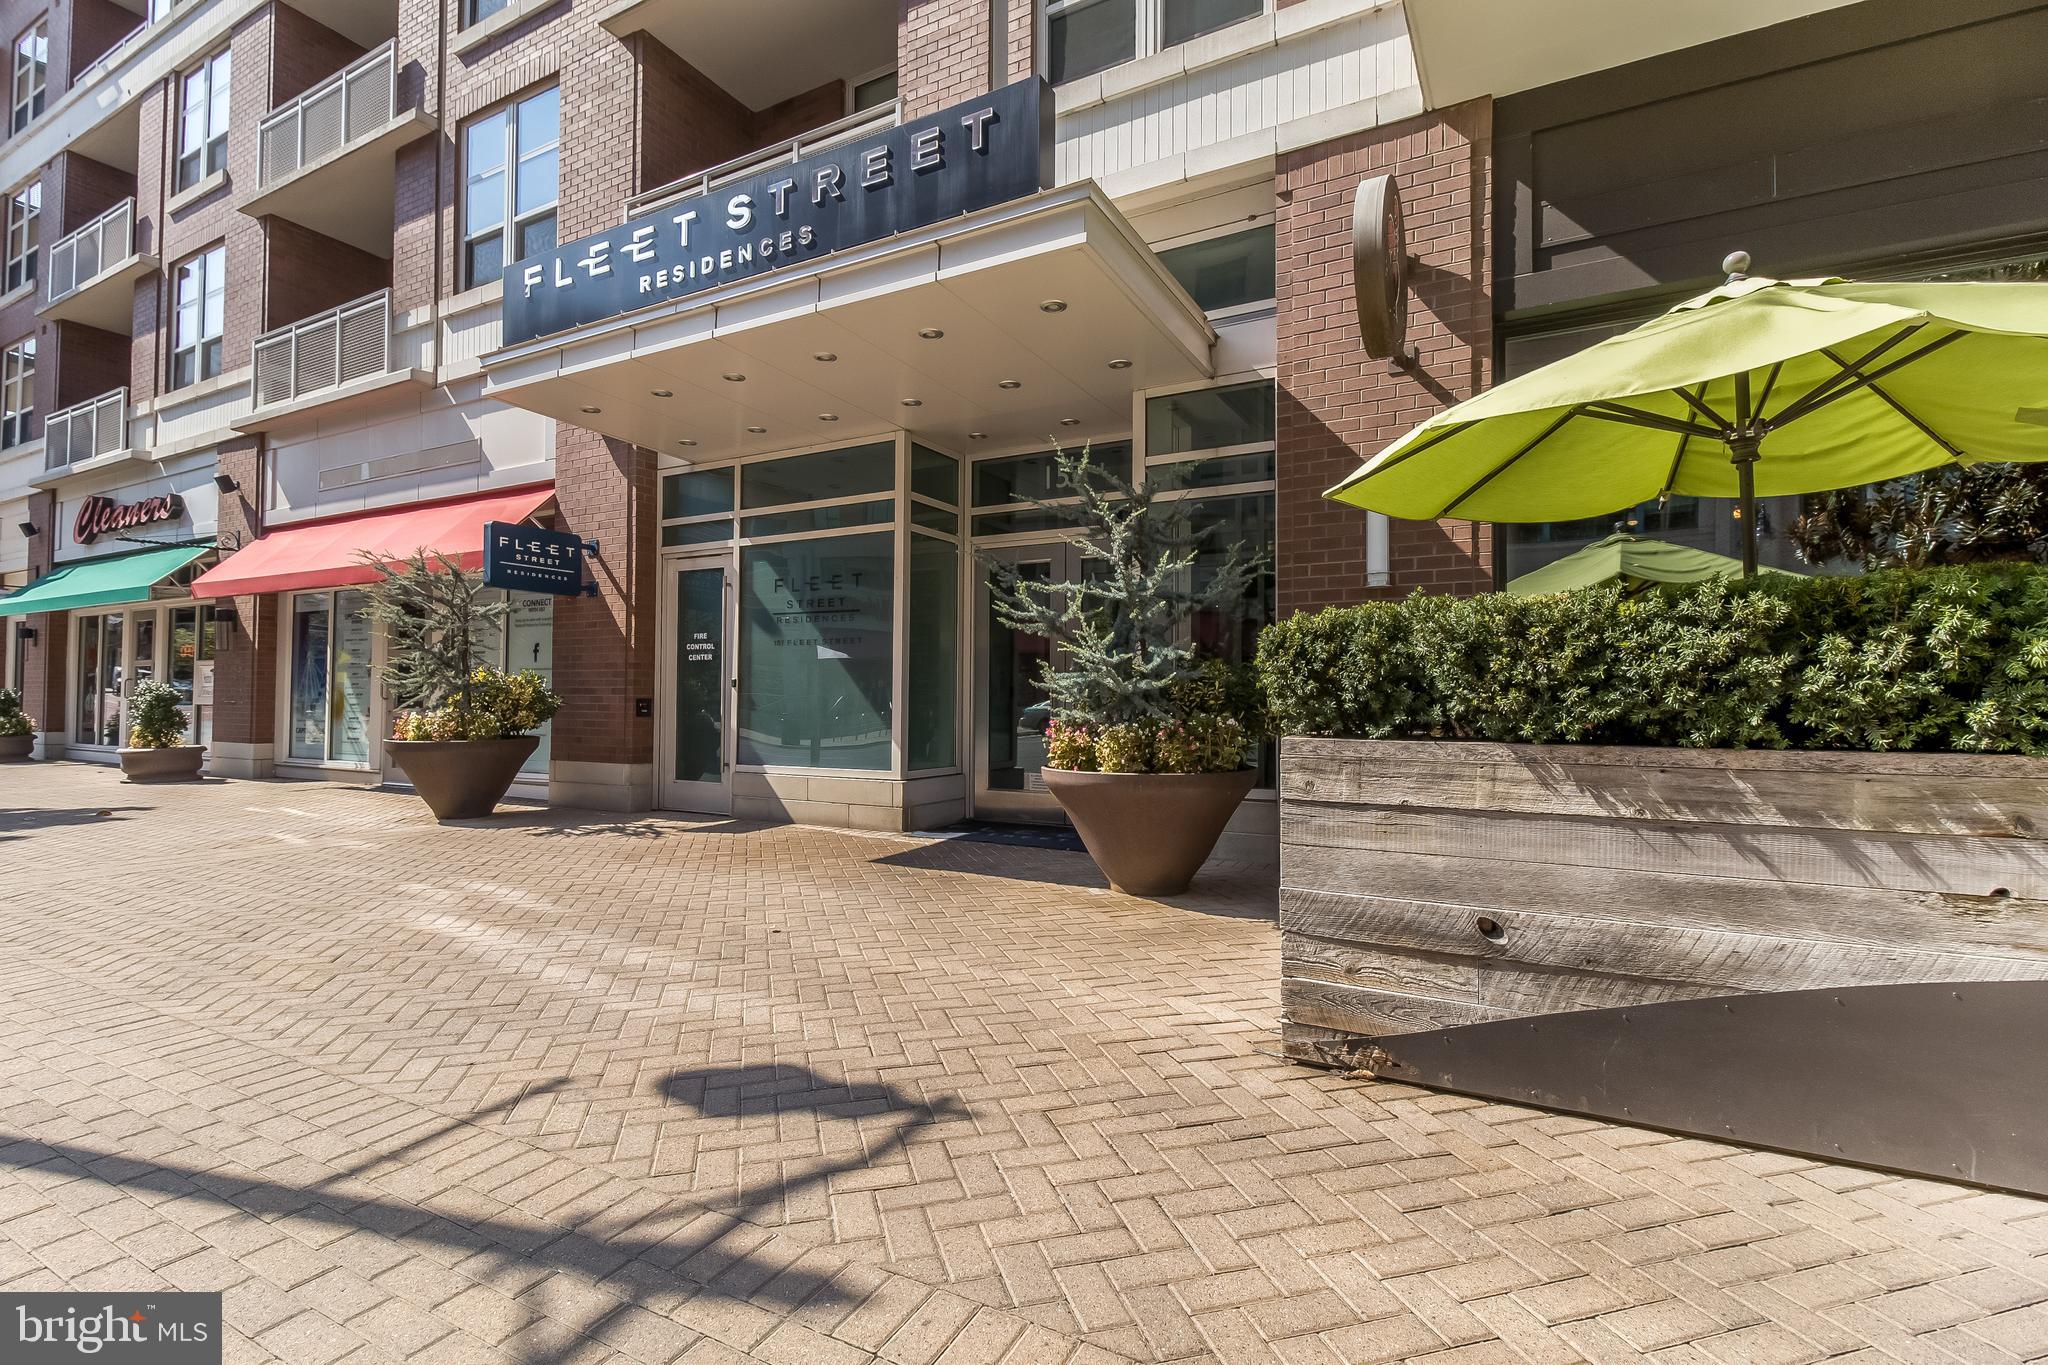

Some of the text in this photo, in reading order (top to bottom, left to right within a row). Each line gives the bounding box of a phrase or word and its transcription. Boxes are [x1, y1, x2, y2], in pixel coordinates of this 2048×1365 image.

[523, 107, 995, 298] FLEET STREET
[639, 224, 815, 293] RESIDENCES
[73, 493, 178, 545] Cleaners
[499, 536, 575, 558] FLEET
[516, 553, 560, 566] STREET
[506, 569, 568, 581] RESIDENCES
[774, 572, 863, 594] FLEET
[522, 598, 552, 607] CONNECT
[786, 597, 846, 609] STREET
[776, 614, 856, 624] RESIDENCES
[693, 632, 708, 640] FIRE
[688, 653, 713, 661] CENTER
